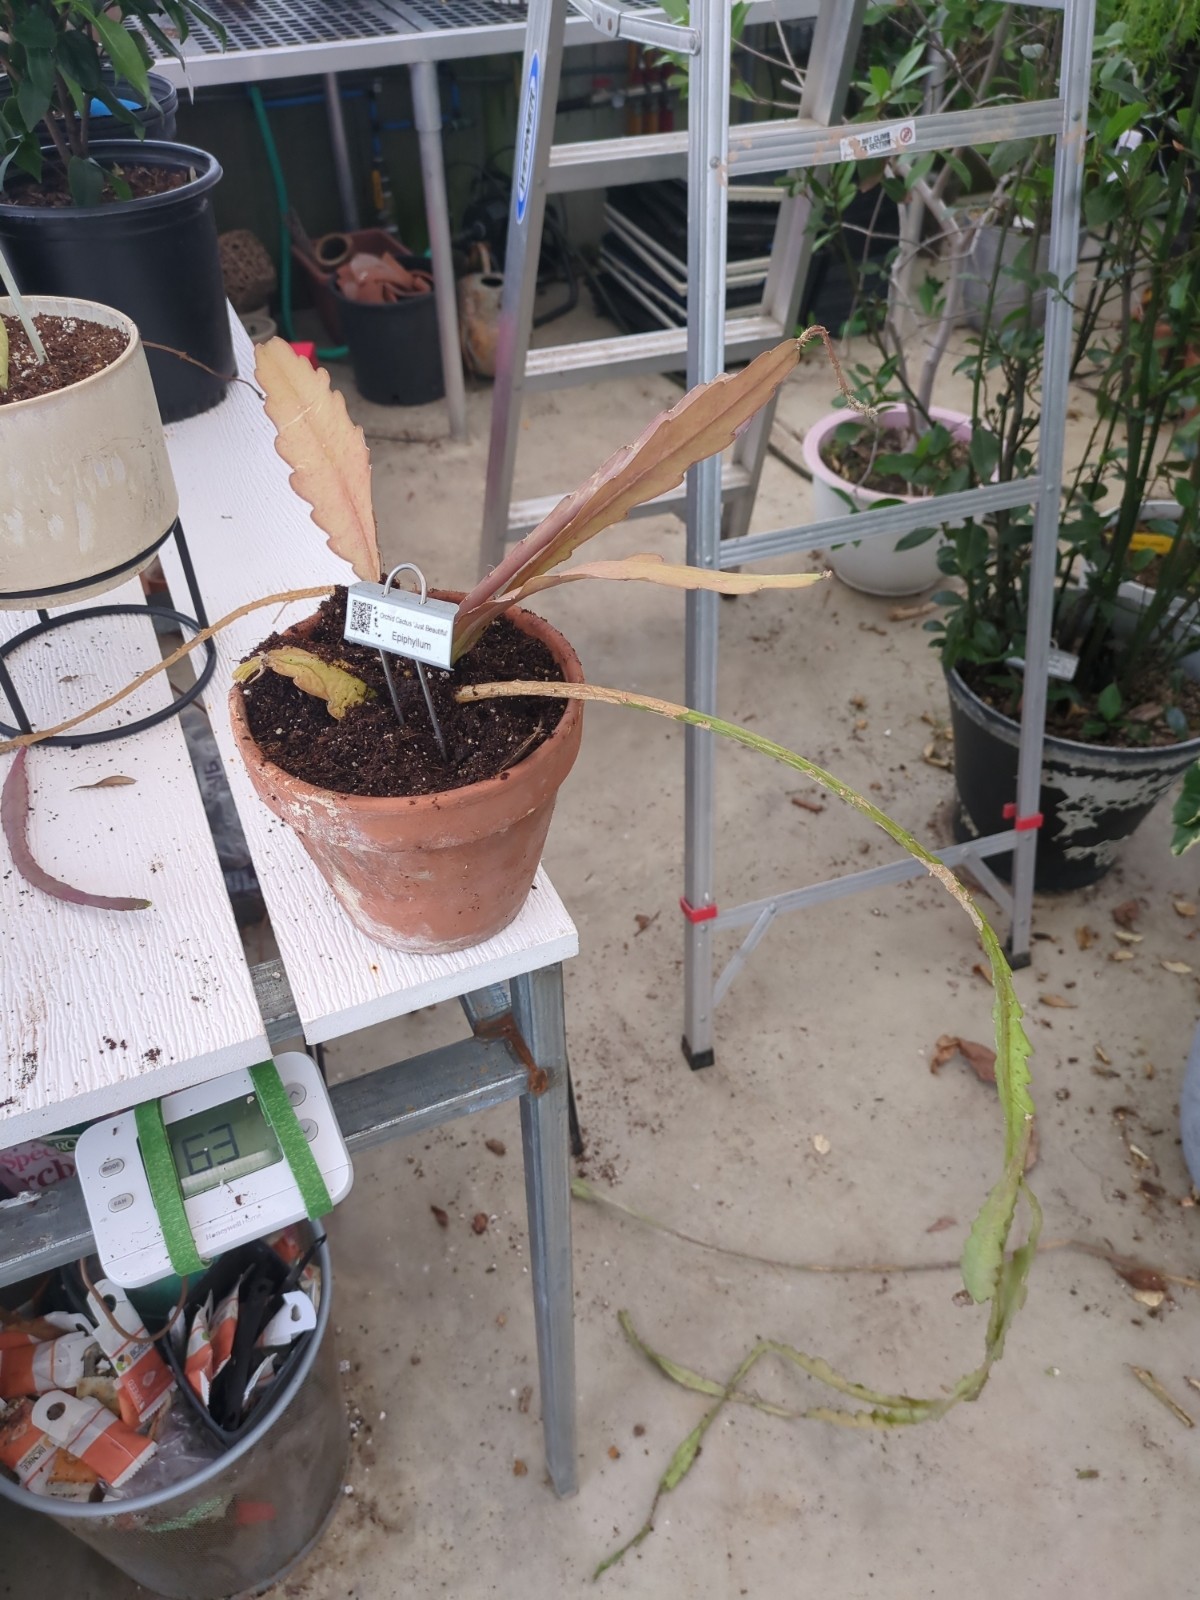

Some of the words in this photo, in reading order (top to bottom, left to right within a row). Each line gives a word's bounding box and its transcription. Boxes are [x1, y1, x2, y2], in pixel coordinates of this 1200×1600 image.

[873, 132, 891, 142] CLIMB
[379, 612, 396, 622] Orchid
[396, 617, 412, 627] Cactus
[392, 631, 432, 650] Epiphyllum
[181, 1122, 240, 1176] 63
[102, 1162, 120, 1174] MODE
[113, 1197, 128, 1208] FAN
